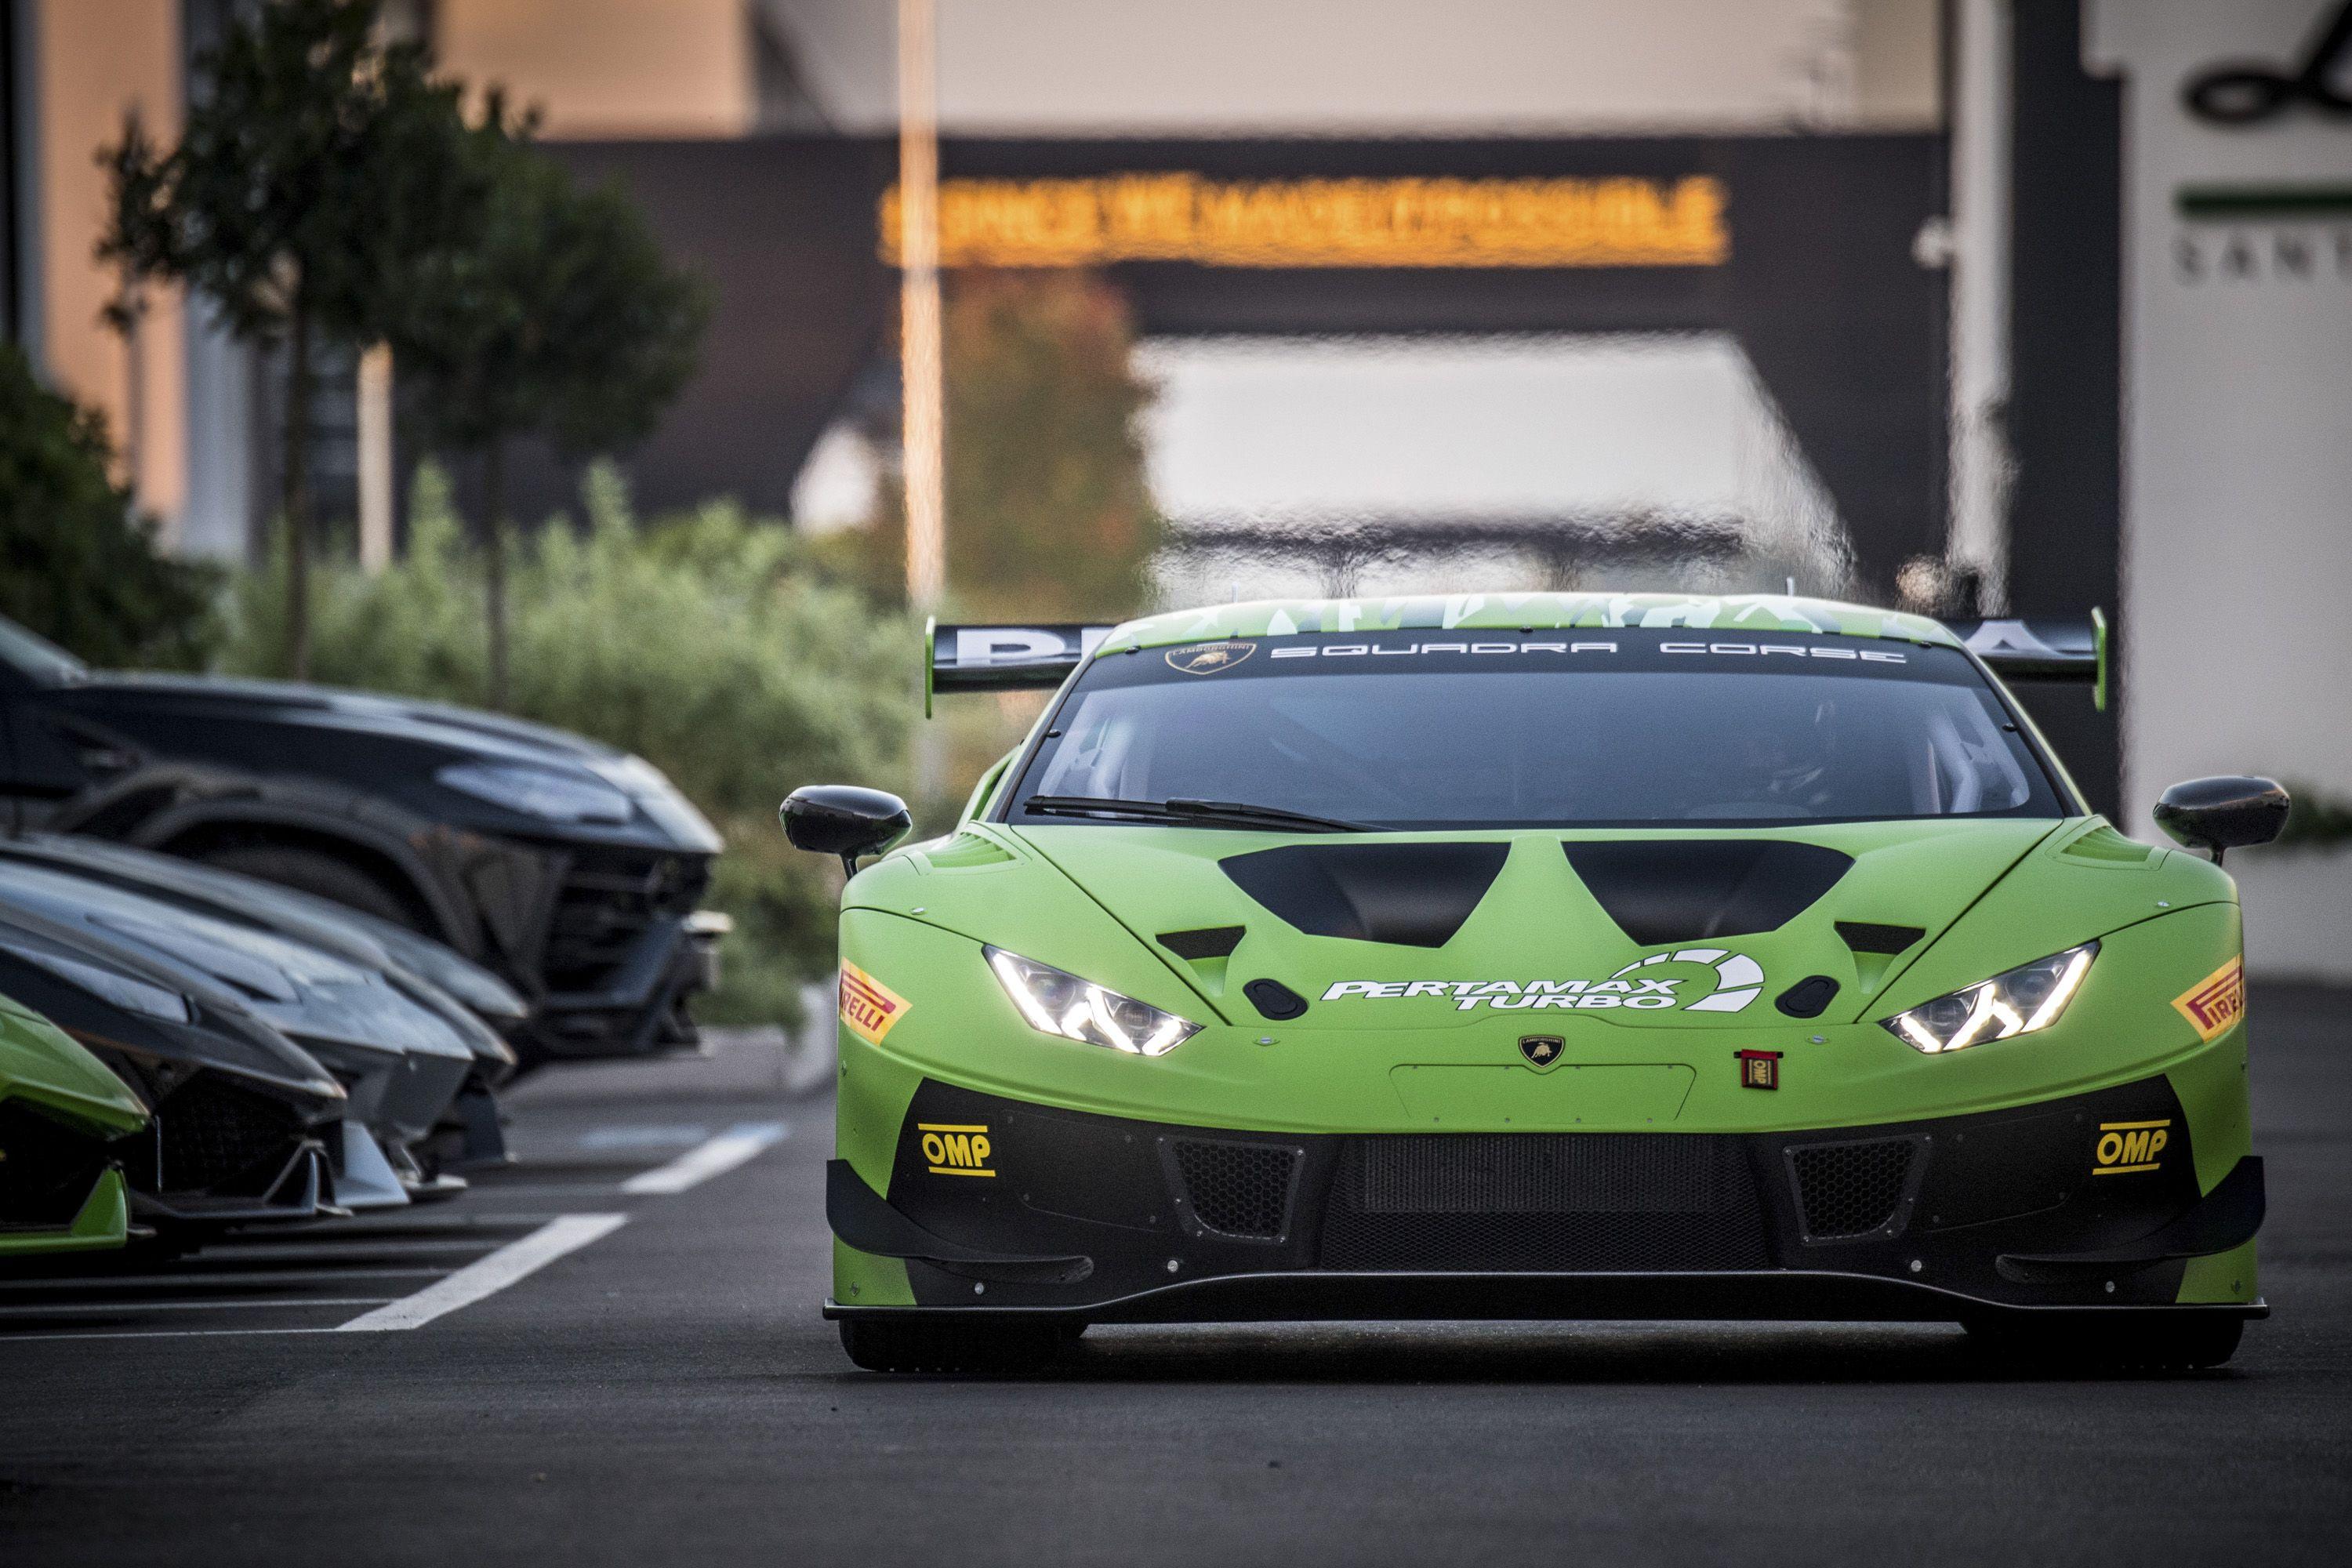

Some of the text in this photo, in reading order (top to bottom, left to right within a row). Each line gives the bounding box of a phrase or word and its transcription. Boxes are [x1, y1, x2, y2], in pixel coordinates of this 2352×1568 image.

[1270, 642, 1907, 664] SQUADRA CORSE
[1320, 981, 1688, 1000] PERTAMAX
[1456, 996, 1677, 1011] TURBO
[1753, 1060, 1766, 1084] OMP
[922, 1133, 990, 1167] OMP
[2096, 1129, 2168, 1165] OMP
